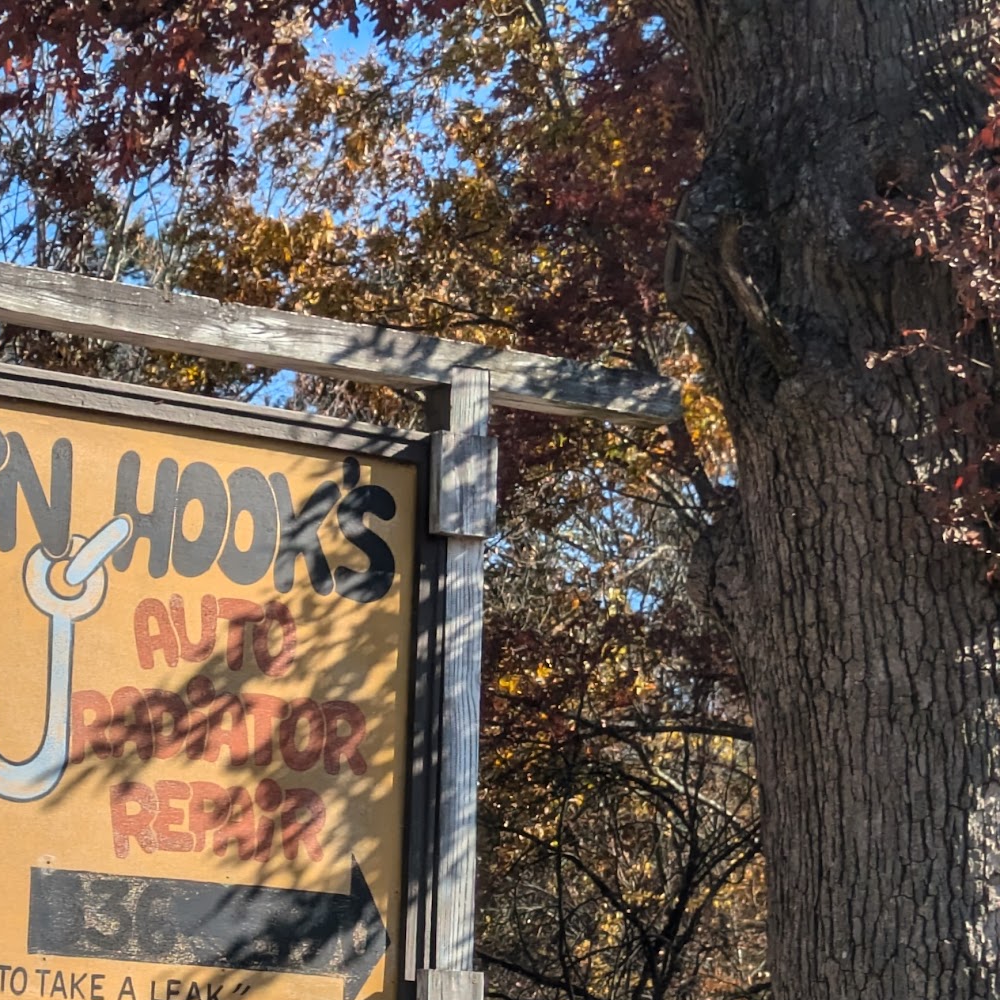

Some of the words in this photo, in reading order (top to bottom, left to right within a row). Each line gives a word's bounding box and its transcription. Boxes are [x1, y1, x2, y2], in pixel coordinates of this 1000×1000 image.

[112, 450, 396, 603] HOOK'S
[134, 593, 296, 677] AUTO
[35, 968, 105, 1000] TAKE
